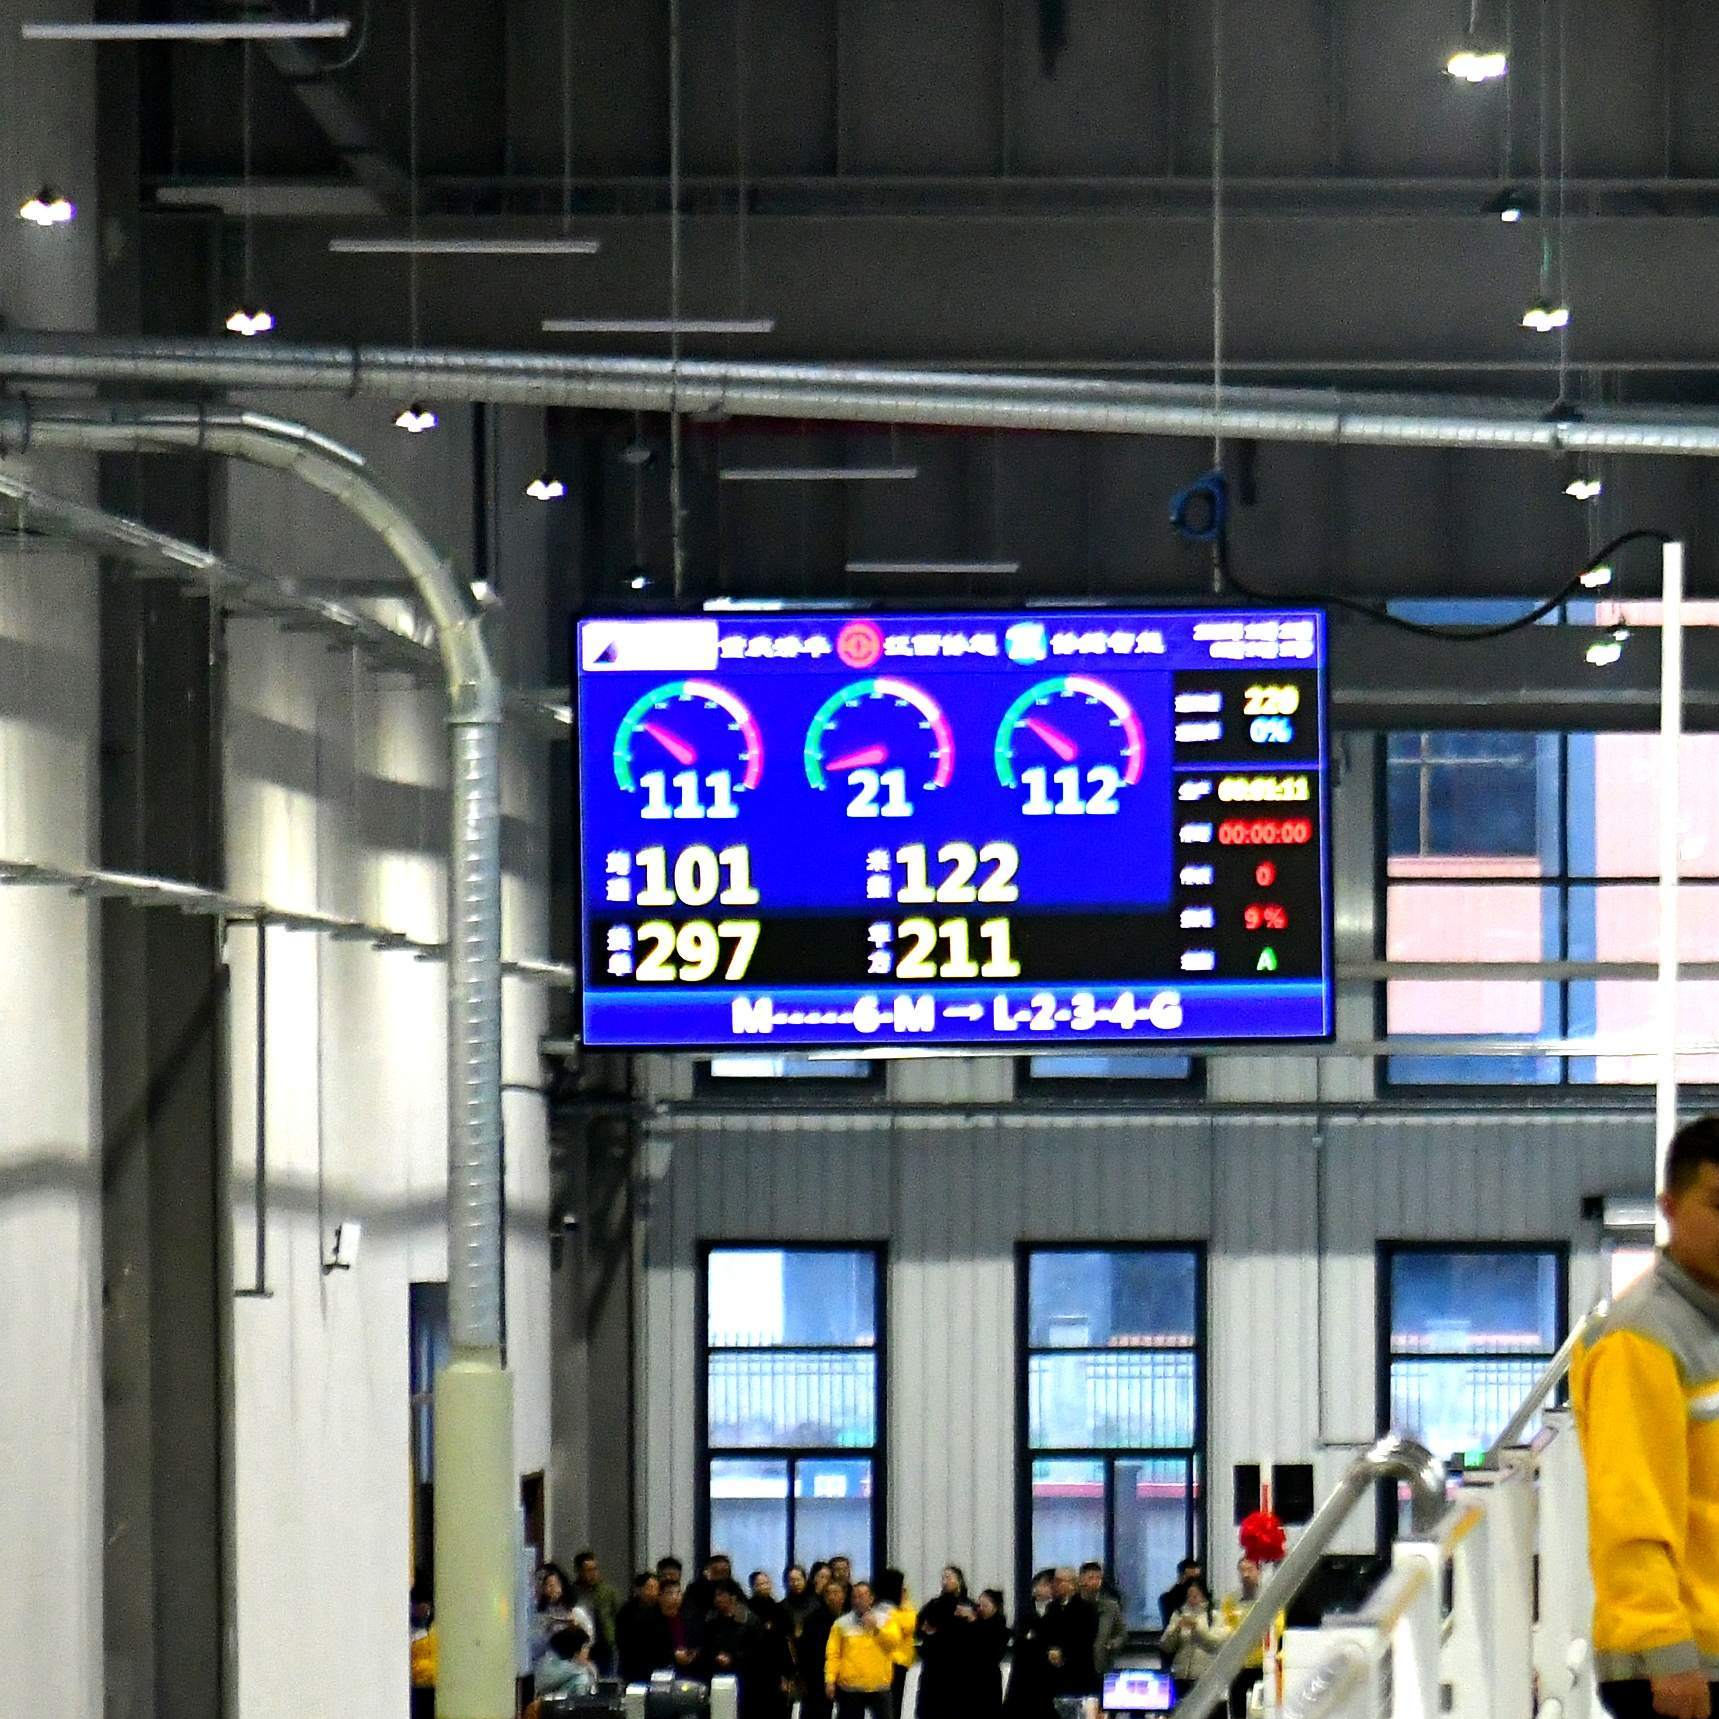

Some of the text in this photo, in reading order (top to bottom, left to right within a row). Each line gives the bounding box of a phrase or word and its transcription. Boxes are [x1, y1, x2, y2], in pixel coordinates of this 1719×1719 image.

[640, 770, 739, 819] 111
[846, 768, 915, 818] 21
[1021, 765, 1120, 815] 112
[1219, 818, 1312, 845] 00:00:00
[636, 844, 760, 906] 101
[896, 840, 1019, 903] 122
[1256, 861, 1276, 887] 0
[635, 918, 761, 982] 297
[896, 915, 1021, 979] 211
[1256, 947, 1278, 971] A
